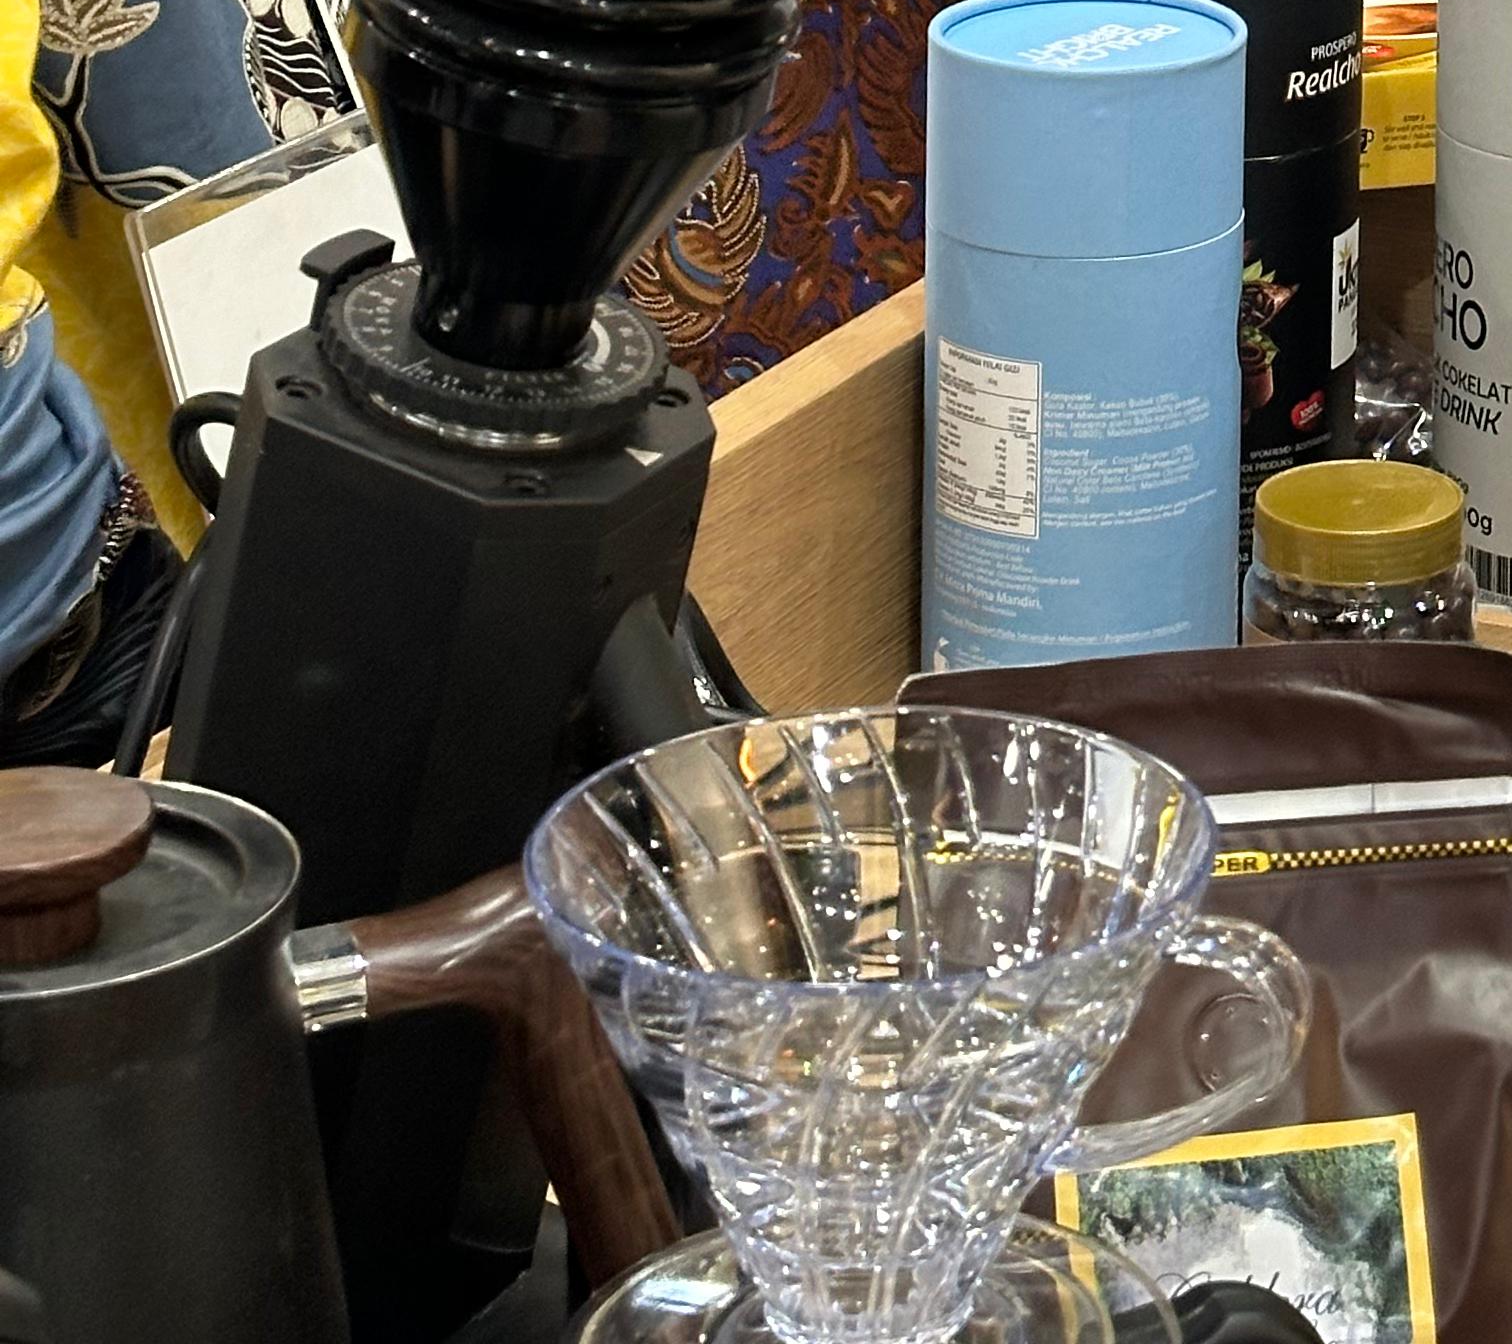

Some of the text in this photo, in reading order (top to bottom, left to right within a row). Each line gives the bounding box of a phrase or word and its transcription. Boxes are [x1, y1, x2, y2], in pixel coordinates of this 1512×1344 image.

[1311, 31, 1358, 62] PROSPERO
[1285, 51, 1362, 101] Realcho
[1442, 360, 1512, 405] COKELAT
[1440, 387, 1503, 436] DRINK
[1212, 856, 1260, 872] PER
